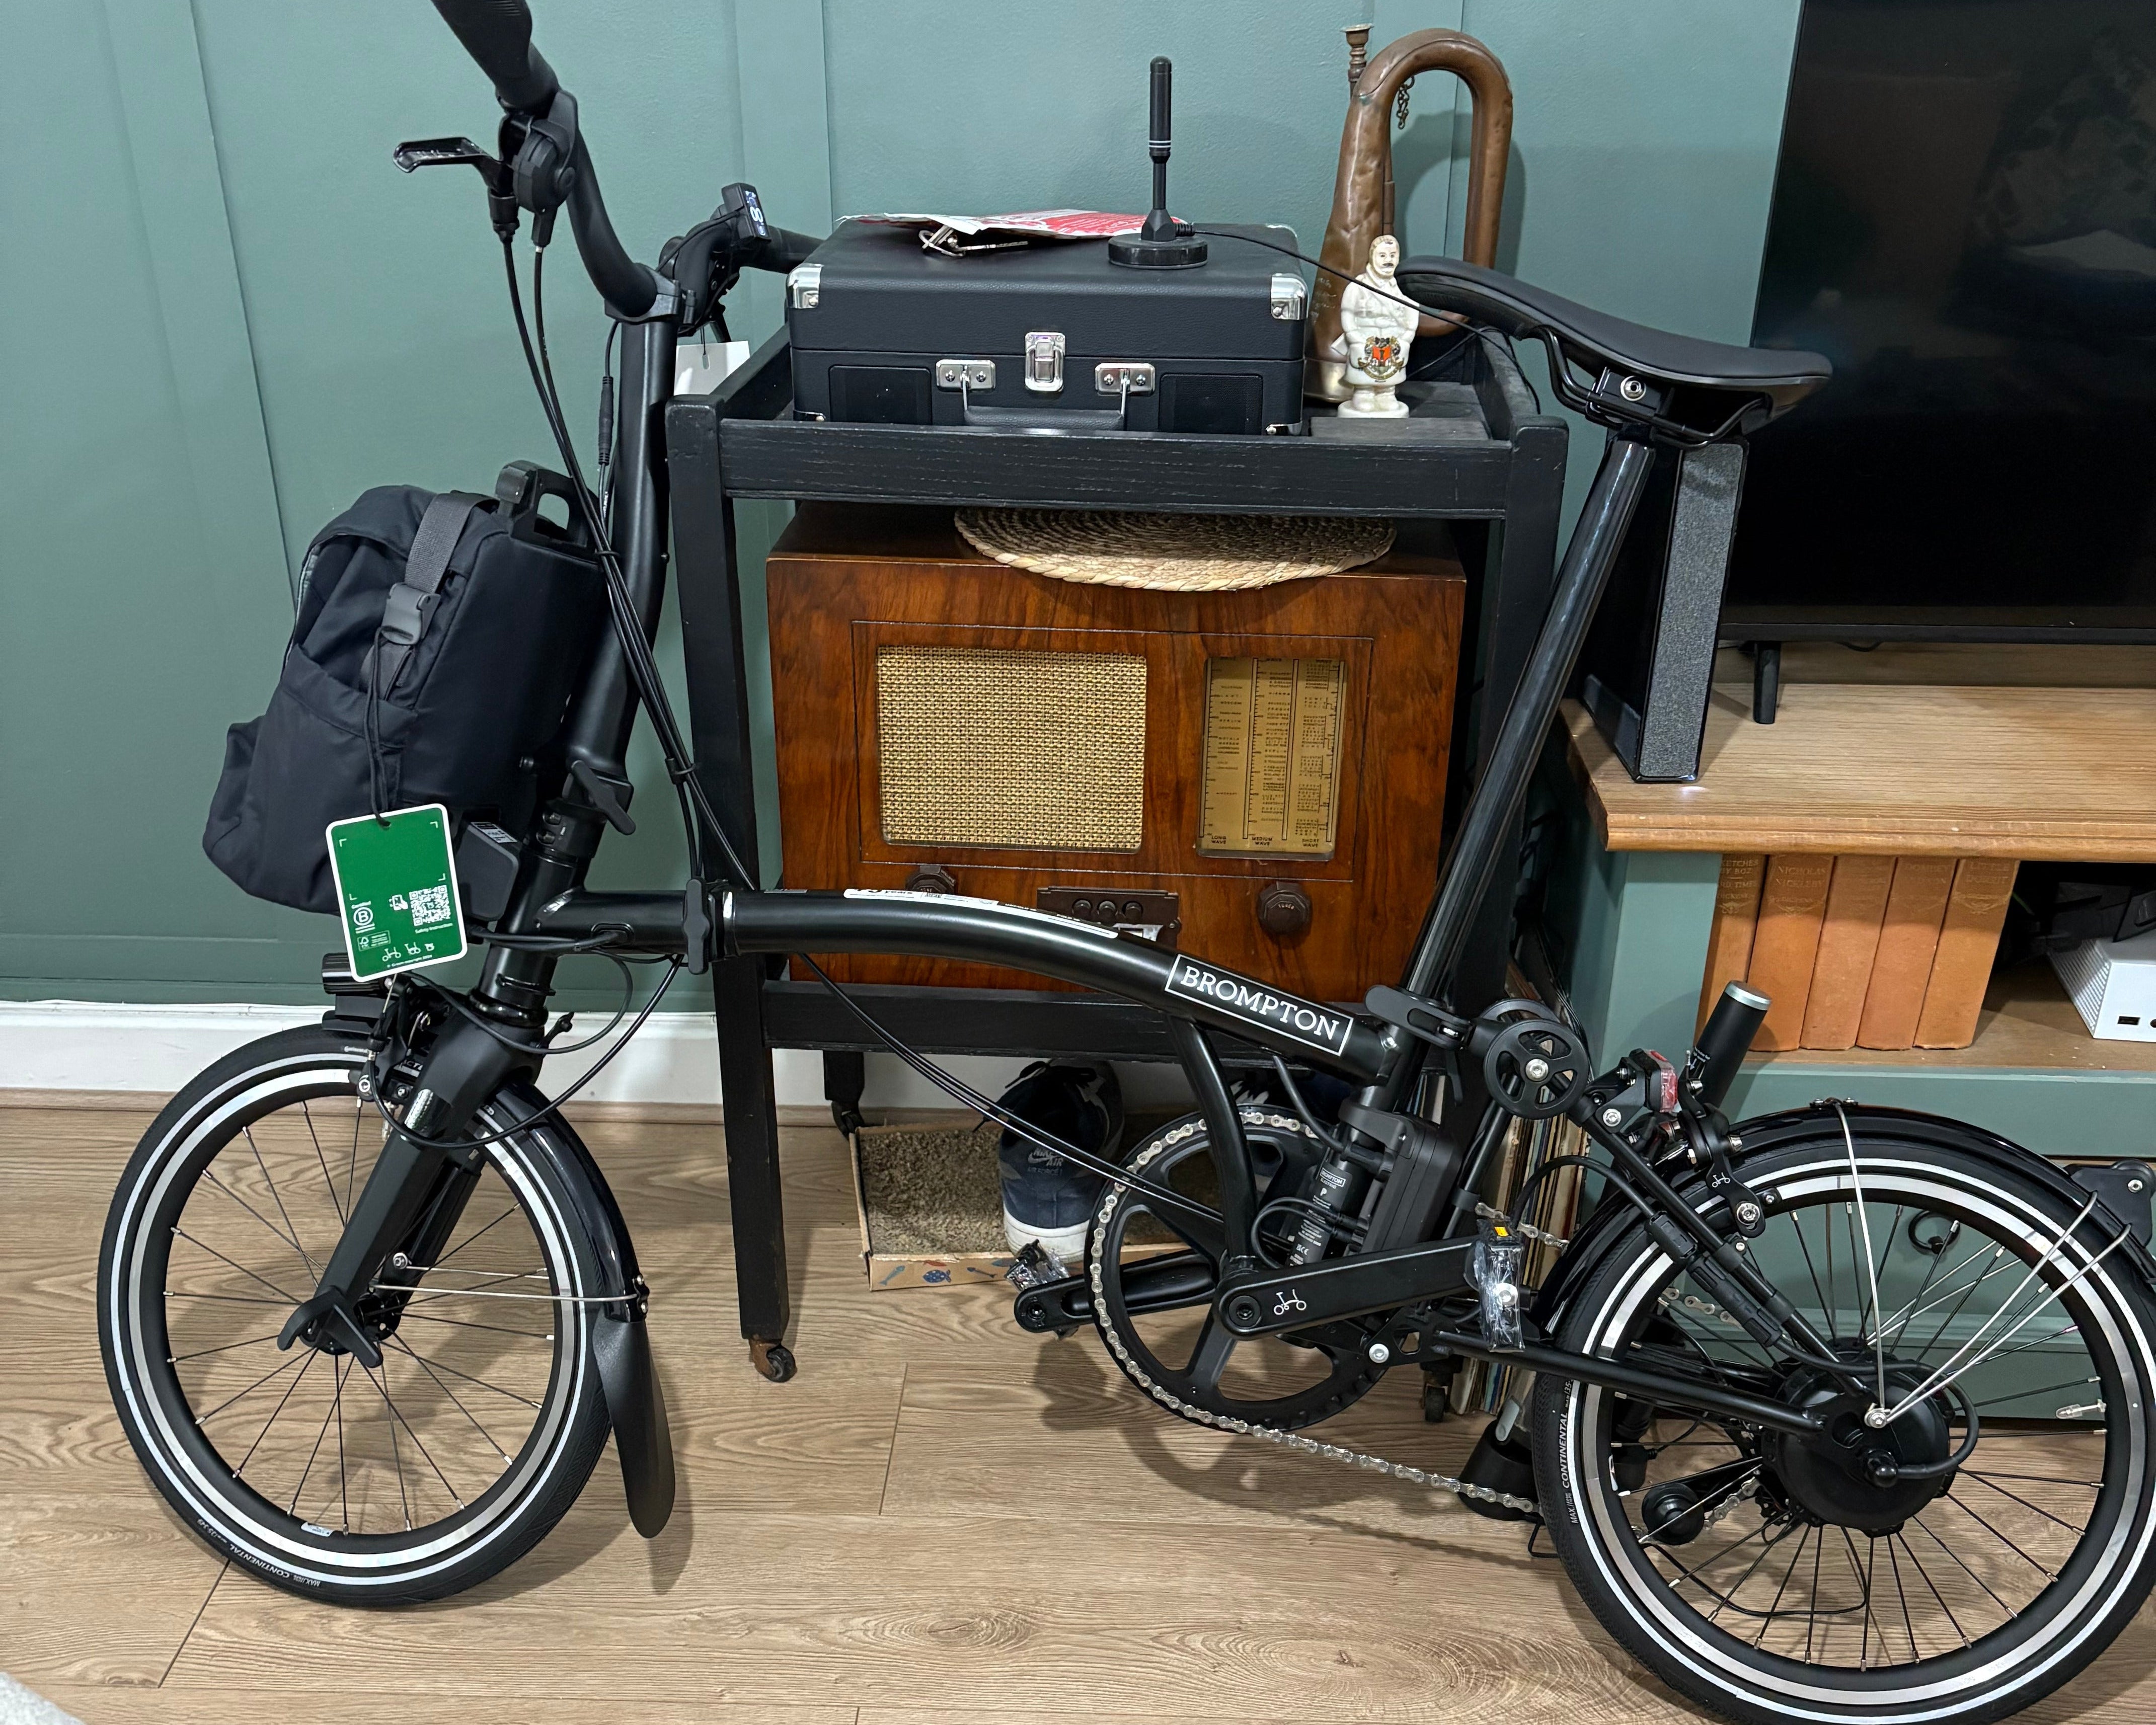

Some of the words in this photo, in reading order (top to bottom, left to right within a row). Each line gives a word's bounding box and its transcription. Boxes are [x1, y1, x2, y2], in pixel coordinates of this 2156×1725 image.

[1778, 866, 1826, 876] NICHOLAS
[1180, 965, 1340, 1041] BROMPTON
[1046, 1157, 1064, 1166] AIR
[1559, 1412, 1570, 1489] CONTINENTAL
[229, 1543, 290, 1579] CONTINENTAL
